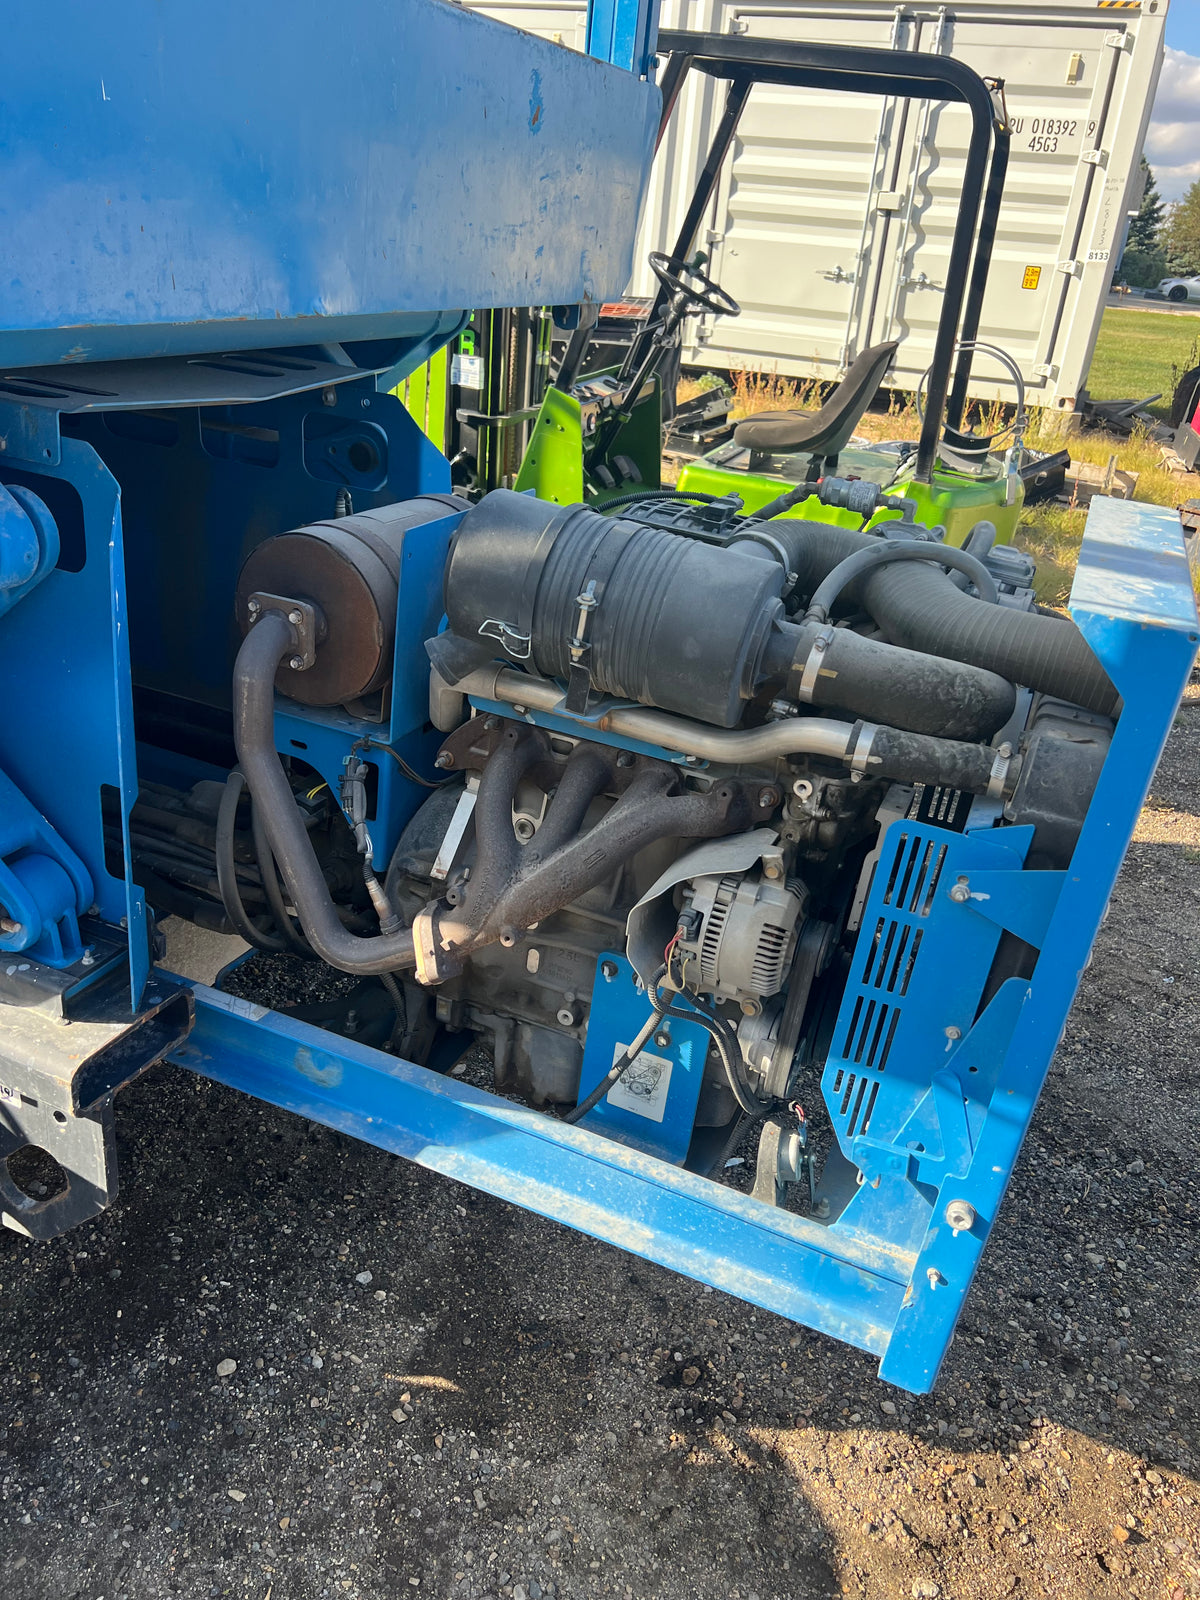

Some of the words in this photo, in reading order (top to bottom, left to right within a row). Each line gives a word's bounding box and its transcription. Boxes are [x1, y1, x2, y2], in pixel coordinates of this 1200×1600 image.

[1031, 118, 1077, 137] 018392
[1087, 121, 1096, 137] 9
[1028, 136, 1058, 153] 45G3
[1088, 251, 1109, 261] 8133
